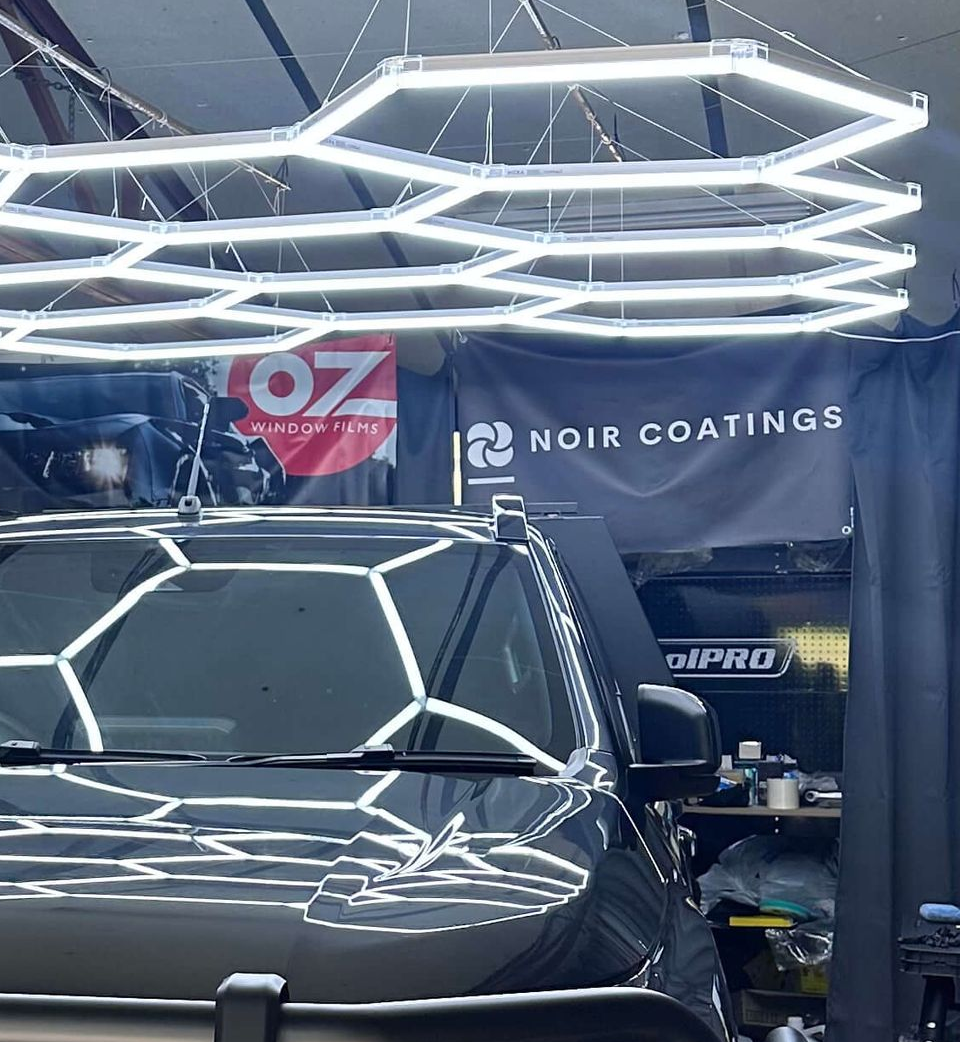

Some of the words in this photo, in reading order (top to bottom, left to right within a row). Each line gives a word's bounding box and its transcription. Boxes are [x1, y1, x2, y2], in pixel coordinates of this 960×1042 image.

[249, 352, 397, 418] OZ
[251, 421, 329, 434] WINDOW
[333, 421, 379, 435] FILMS
[530, 426, 621, 452] NOIR
[639, 405, 843, 445] COATINGS
[665, 648, 776, 669] olPRO
